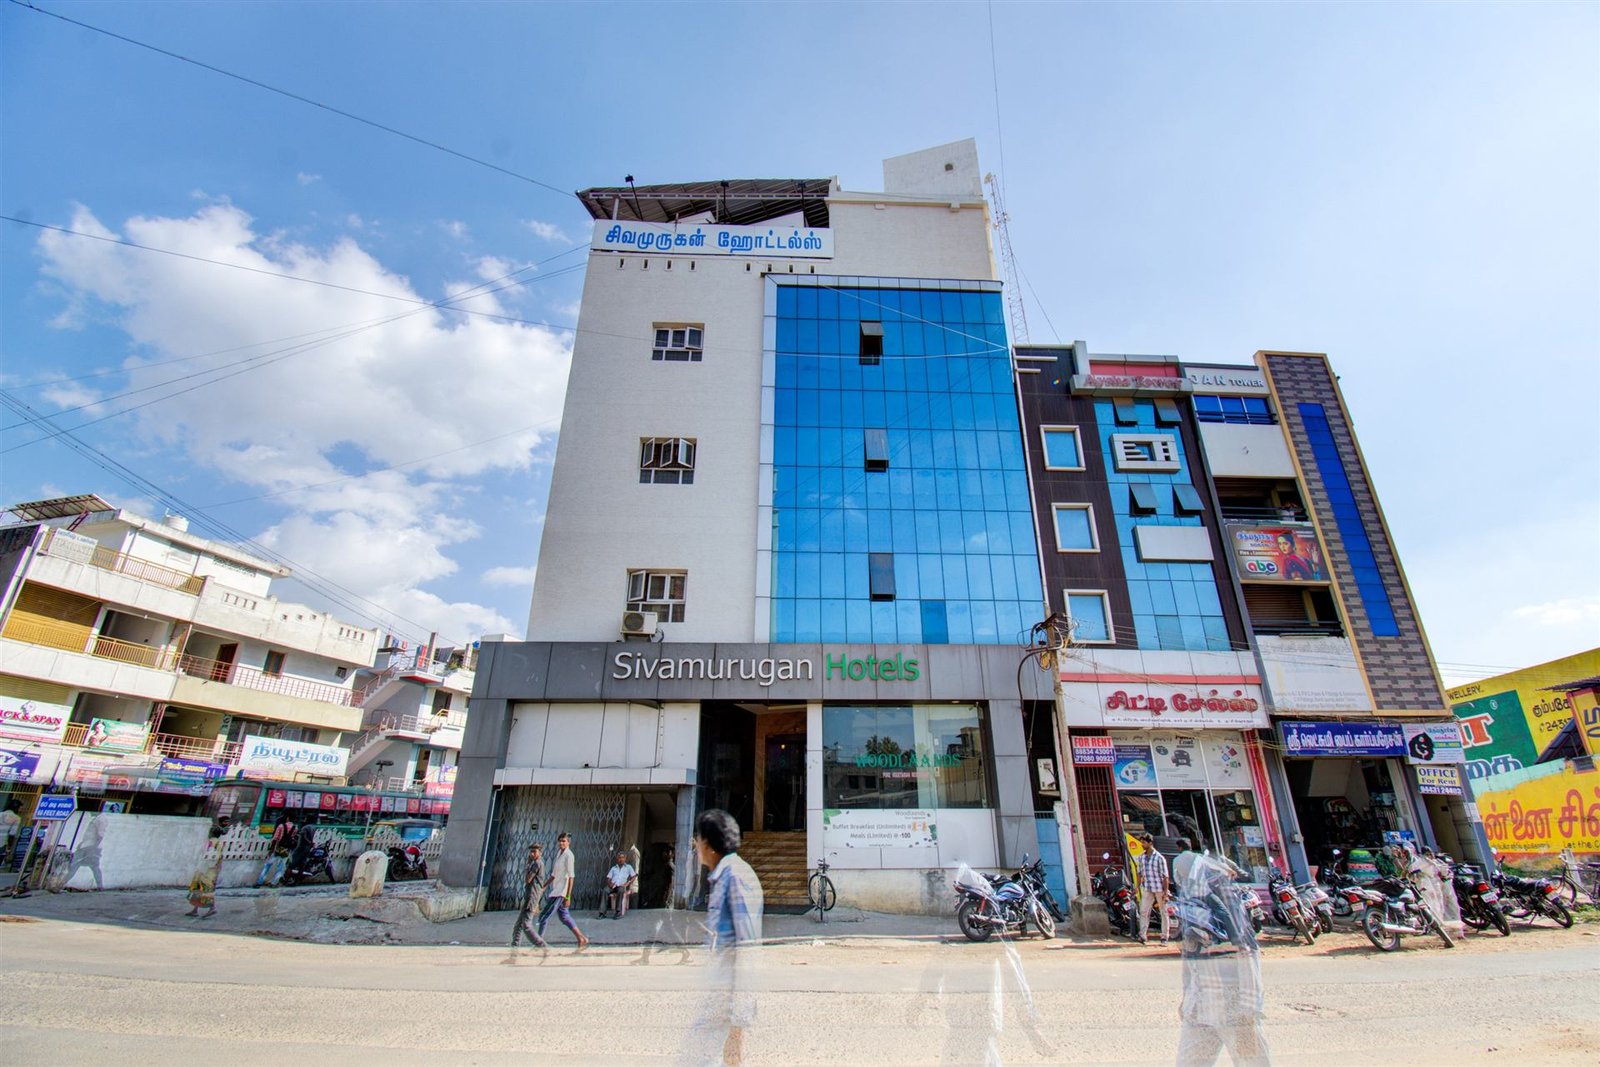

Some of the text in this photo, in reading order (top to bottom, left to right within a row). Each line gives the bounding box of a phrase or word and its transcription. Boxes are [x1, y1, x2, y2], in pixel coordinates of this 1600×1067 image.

[605, 224, 822, 253] சிவமுருகன் ஹோட்டல்ஸ்
[1229, 378, 1265, 388] TOWER
[1247, 560, 1277, 573] abc
[612, 651, 921, 687] Sivamurugan Hotels
[1106, 690, 1168, 716] சிட்டி
[33, 714, 63, 726] SPAN
[1074, 737, 1112, 747] FOR RENT
[1418, 768, 1456, 778] OFFICE
[832, 823, 849, 831] Buffet
[867, 832, 893, 840] (Limited)
